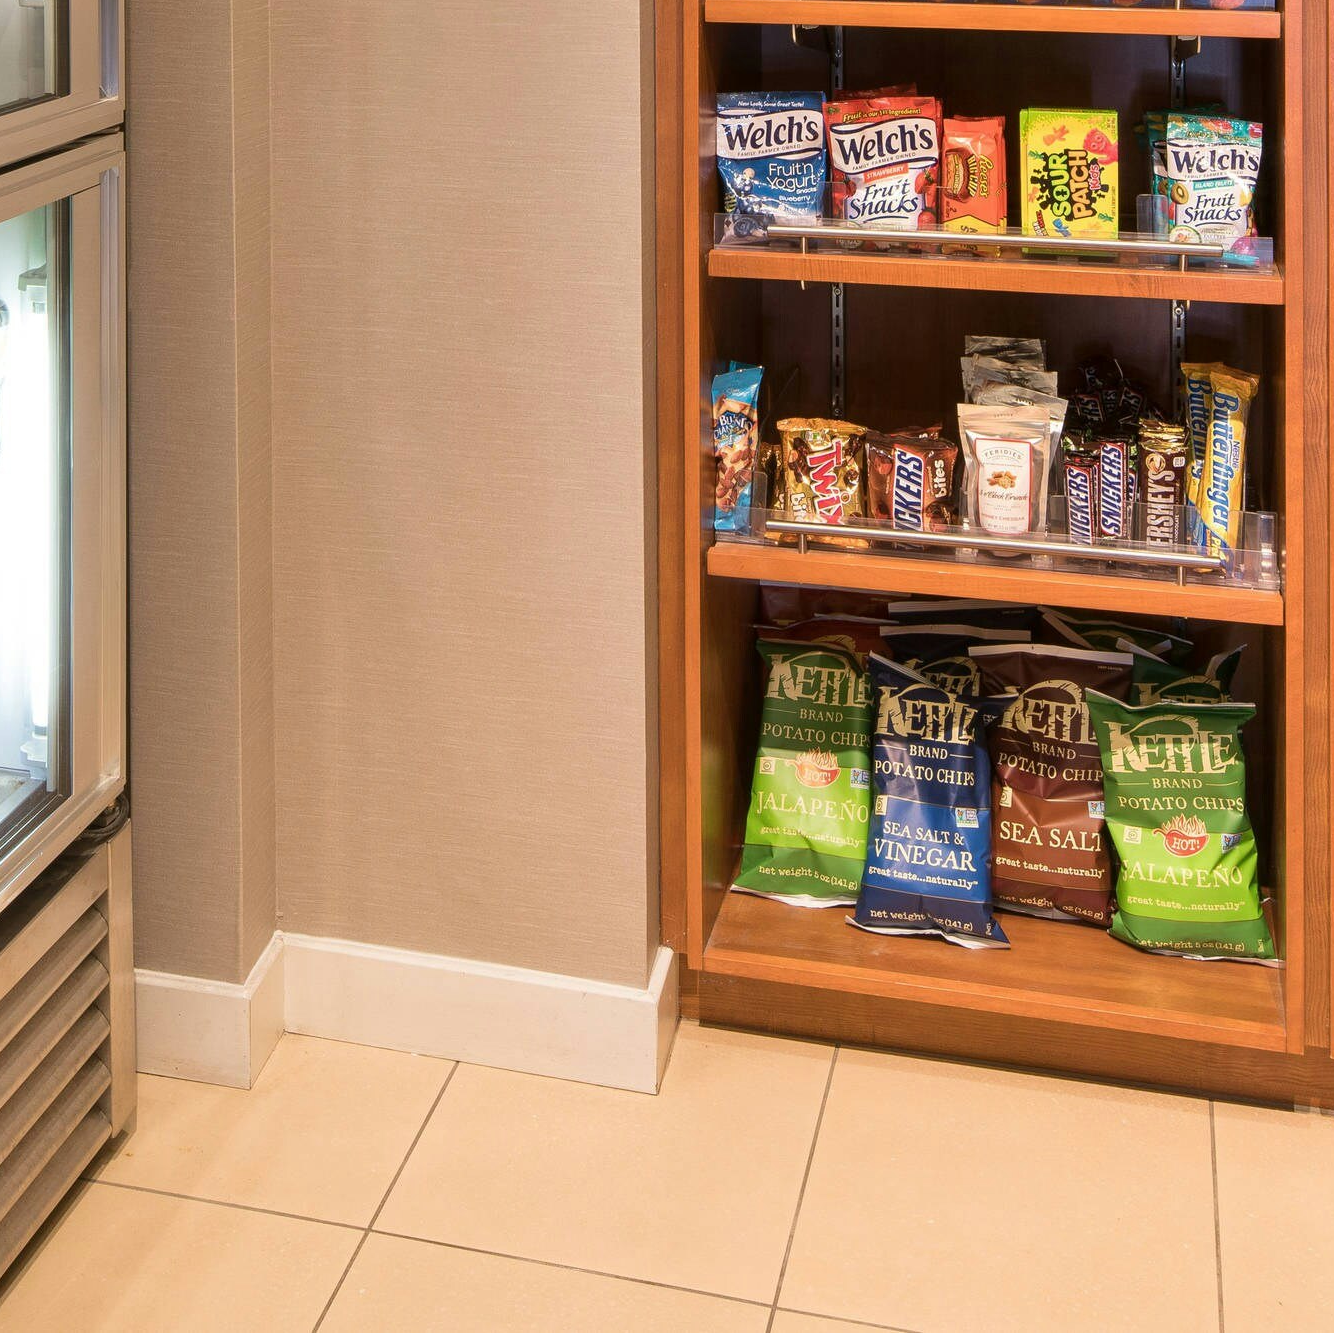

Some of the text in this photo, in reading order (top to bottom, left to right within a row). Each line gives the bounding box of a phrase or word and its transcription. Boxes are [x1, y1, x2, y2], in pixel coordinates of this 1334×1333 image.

[722, 115, 819, 154] Welch's
[835, 124, 934, 164] Welch's
[768, 162, 814, 177] Fruit'n
[866, 166, 906, 180] STRAWBERRY
[1171, 149, 1259, 175] Welch's
[766, 176, 817, 194] Yogurt
[978, 154, 995, 198] Reese's
[1048, 152, 1071, 218] SOUR
[1069, 149, 1094, 220] PATCH
[1089, 164, 1101, 190] Kids
[863, 178, 910, 203] Fruit
[849, 195, 918, 219] Snacks
[1211, 392, 1239, 534] Butterfinger
[934, 459, 946, 498] bites
[1100, 443, 1123, 536] SNICKERS
[909, 745, 948, 760] BRAND
[1103, 714, 1239, 775] KETTLE
[874, 760, 975, 787] POTATO CHIPS
[1117, 796, 1245, 813] POTATO CHIPS
[882, 821, 965, 846] SEA SALT &
[1171, 836, 1201, 851] HOT!
[873, 838, 976, 873] VINEGAR
[869, 864, 892, 880] great
[1122, 859, 1243, 888] JALAPEÑO
